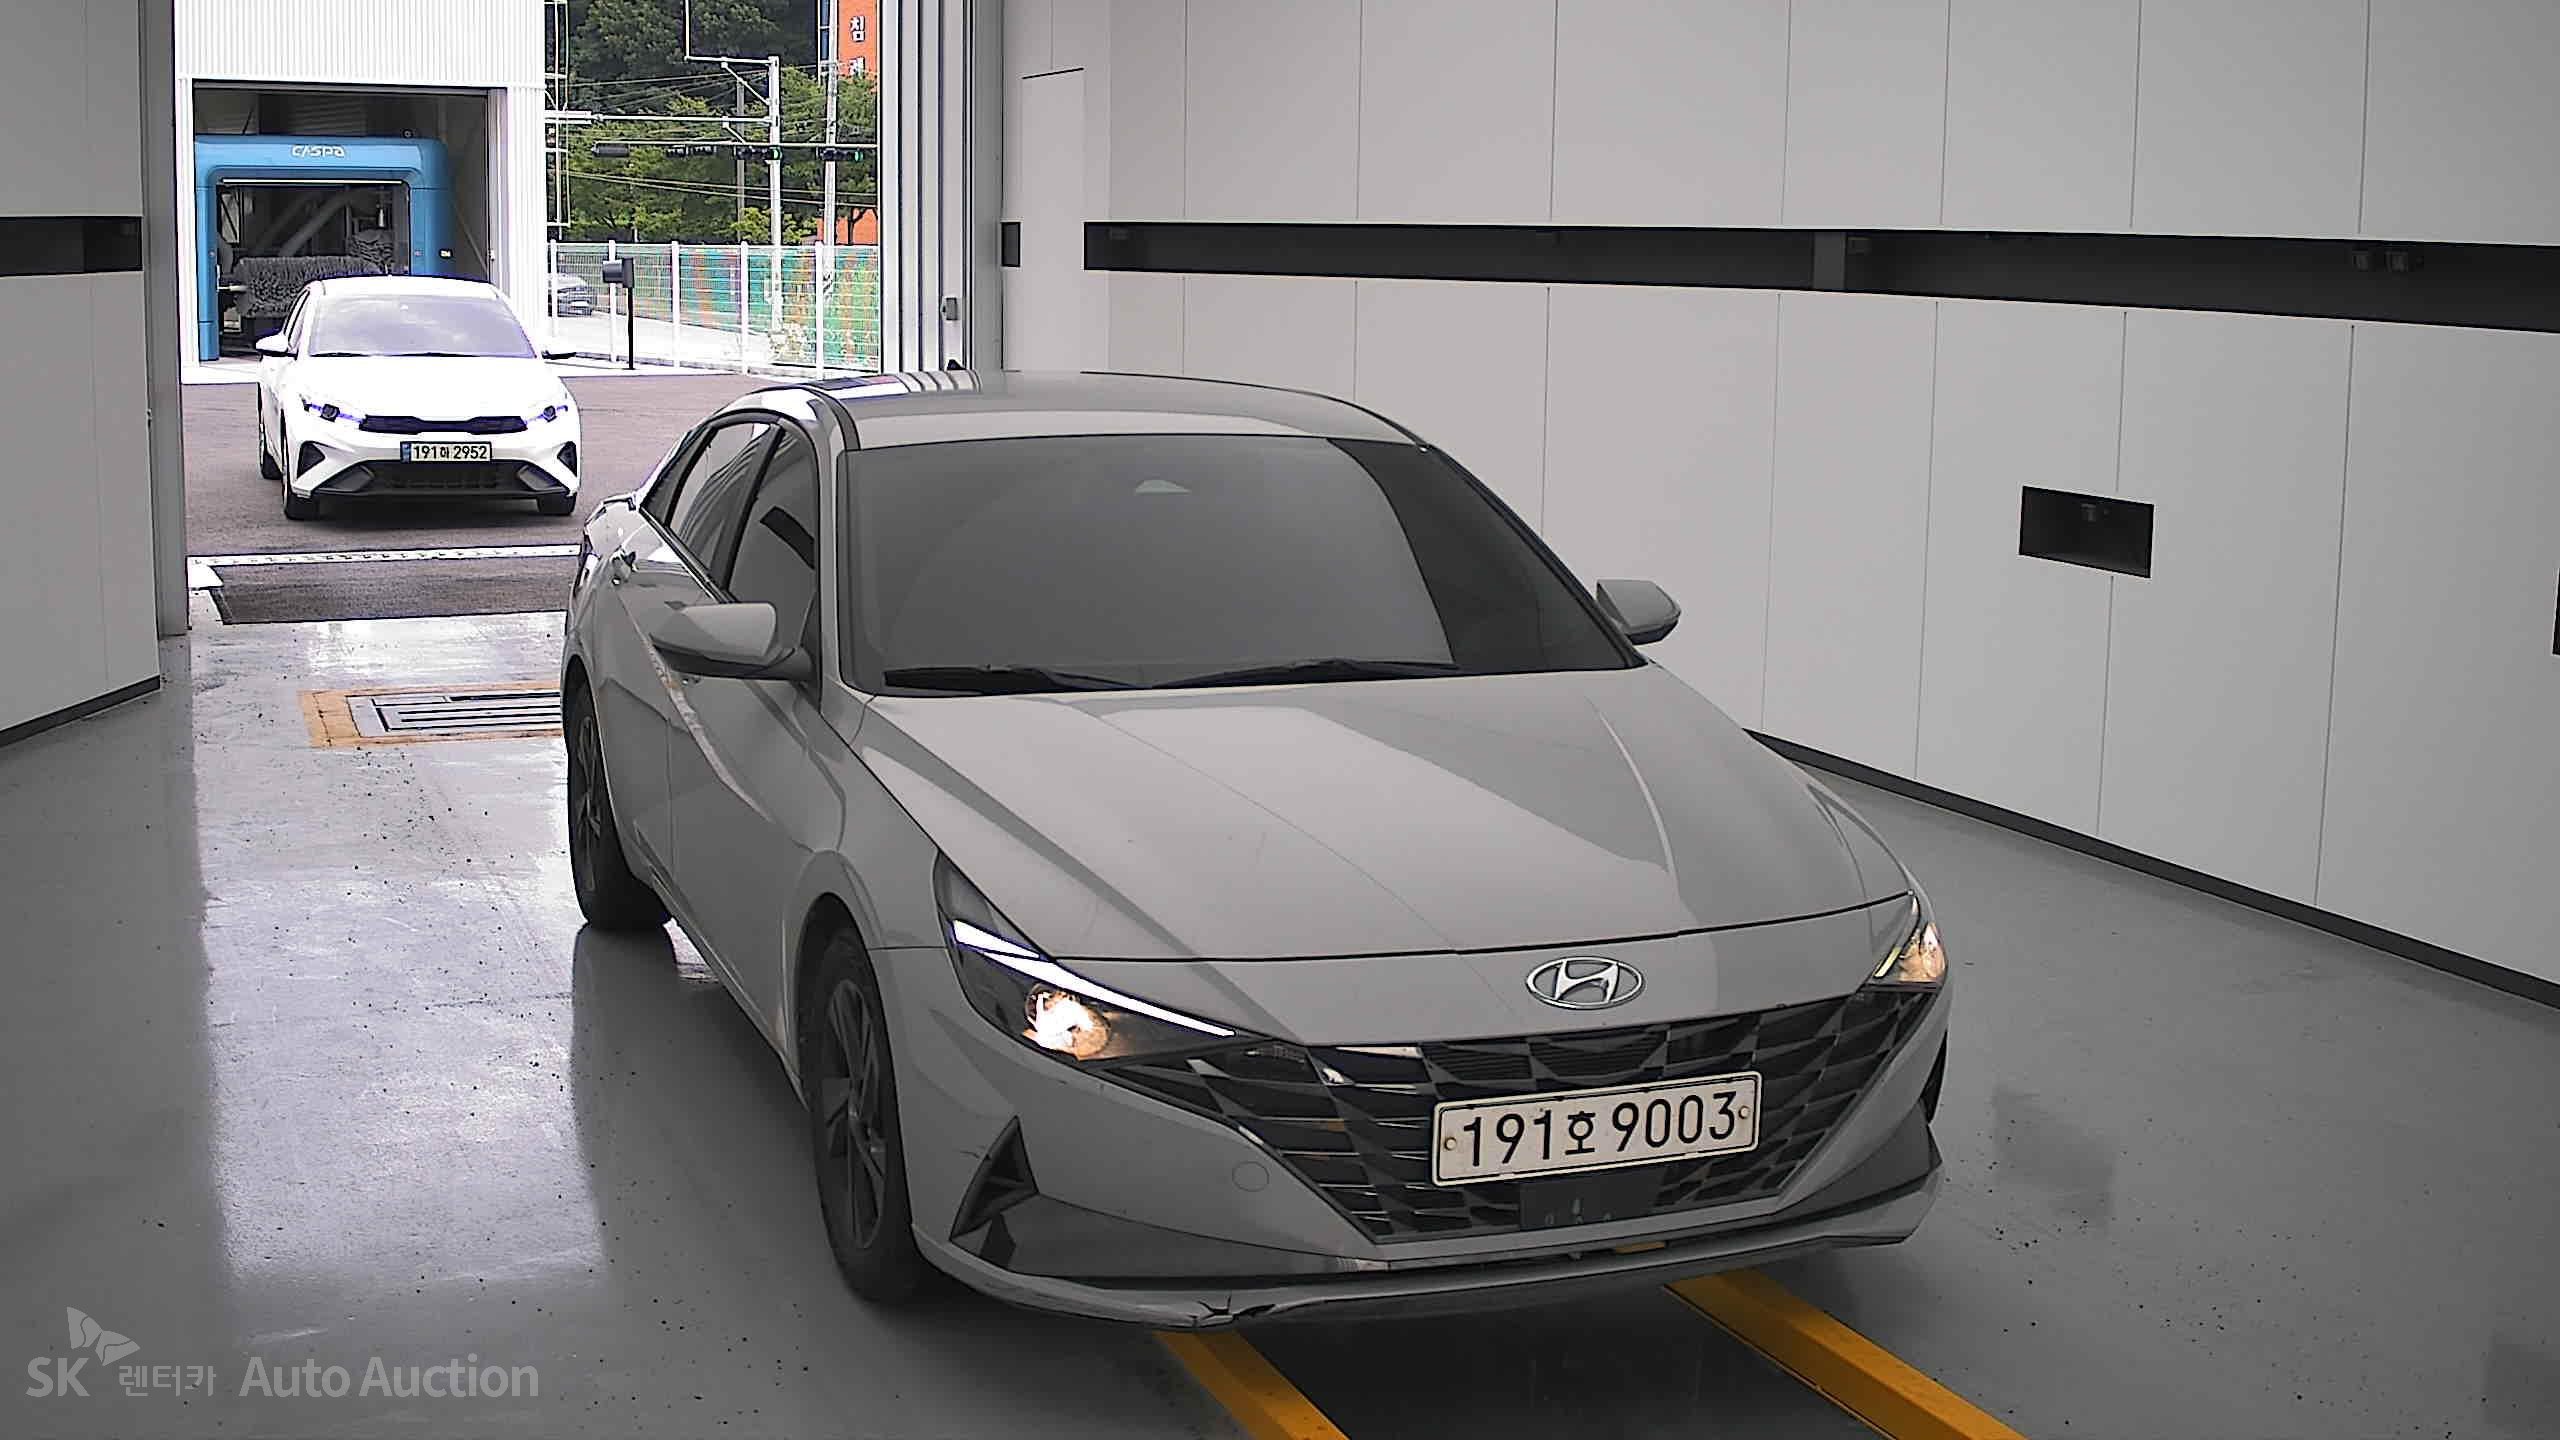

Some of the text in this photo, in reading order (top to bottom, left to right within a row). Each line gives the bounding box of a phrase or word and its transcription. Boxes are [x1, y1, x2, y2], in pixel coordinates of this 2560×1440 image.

[453, 446, 487, 459] 2952
[1463, 1090, 1736, 1167] 191호 9003
